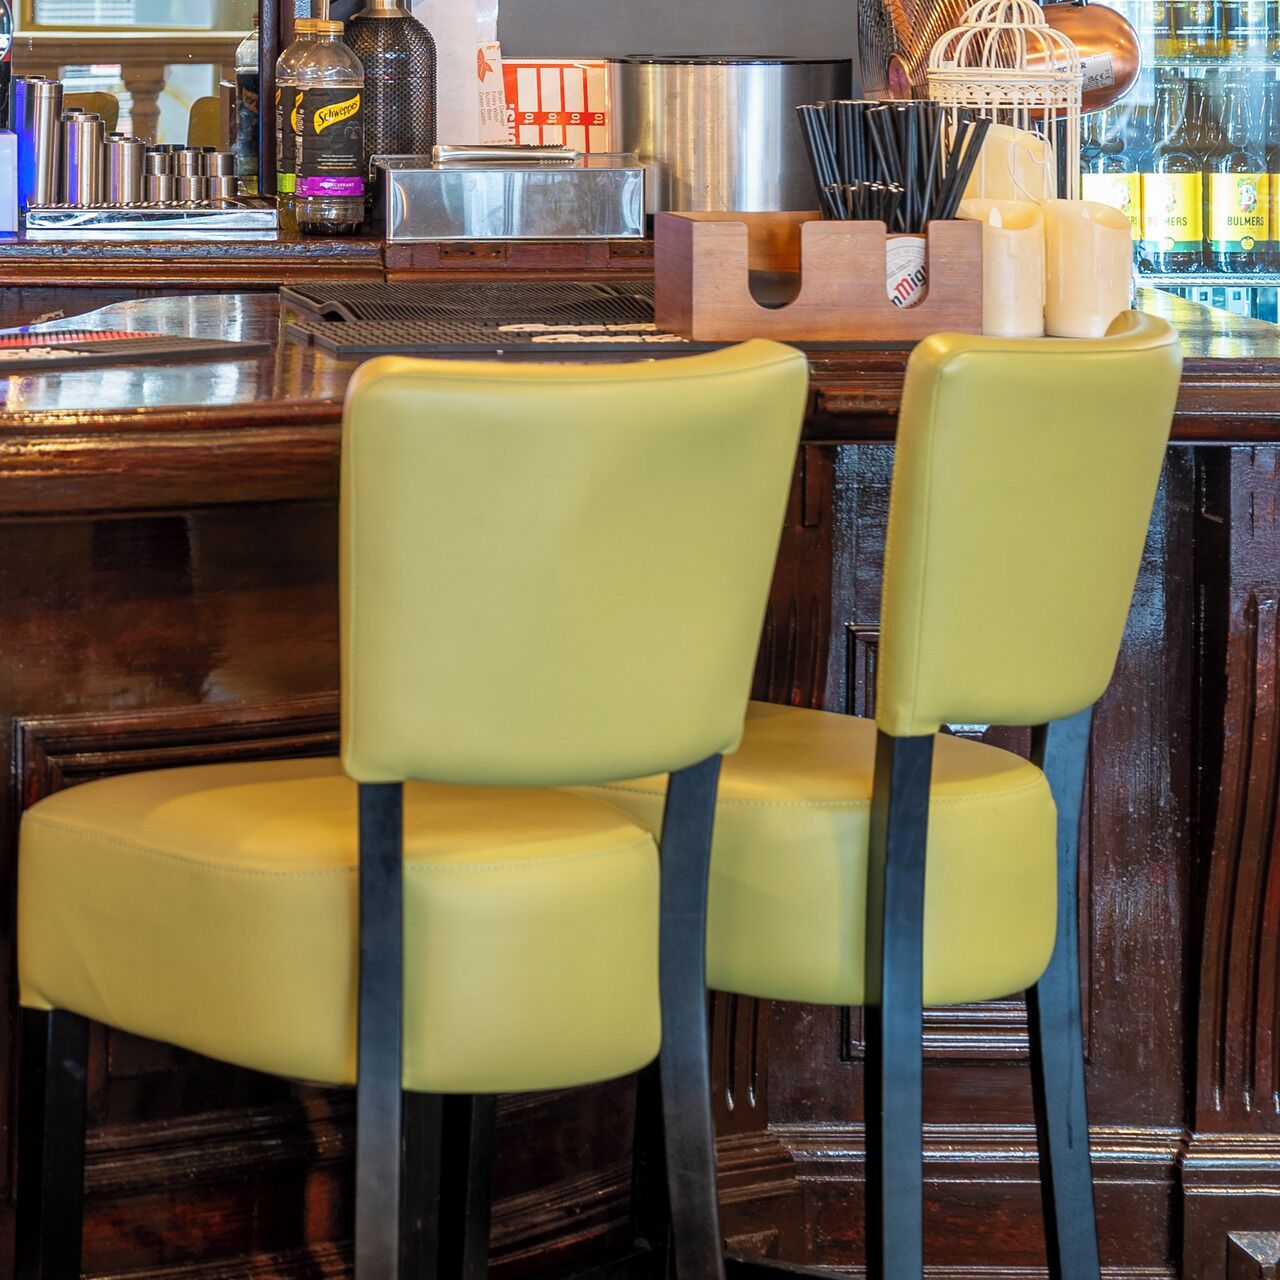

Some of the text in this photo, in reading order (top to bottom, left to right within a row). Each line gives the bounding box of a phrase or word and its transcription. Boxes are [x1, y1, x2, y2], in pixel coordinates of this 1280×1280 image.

[318, 101, 358, 126] Schweppes
[524, 114, 534, 124] to
[547, 113, 557, 124] to
[571, 113, 581, 124] to
[593, 113, 604, 124] to
[1227, 216, 1264, 226] BULMERS
